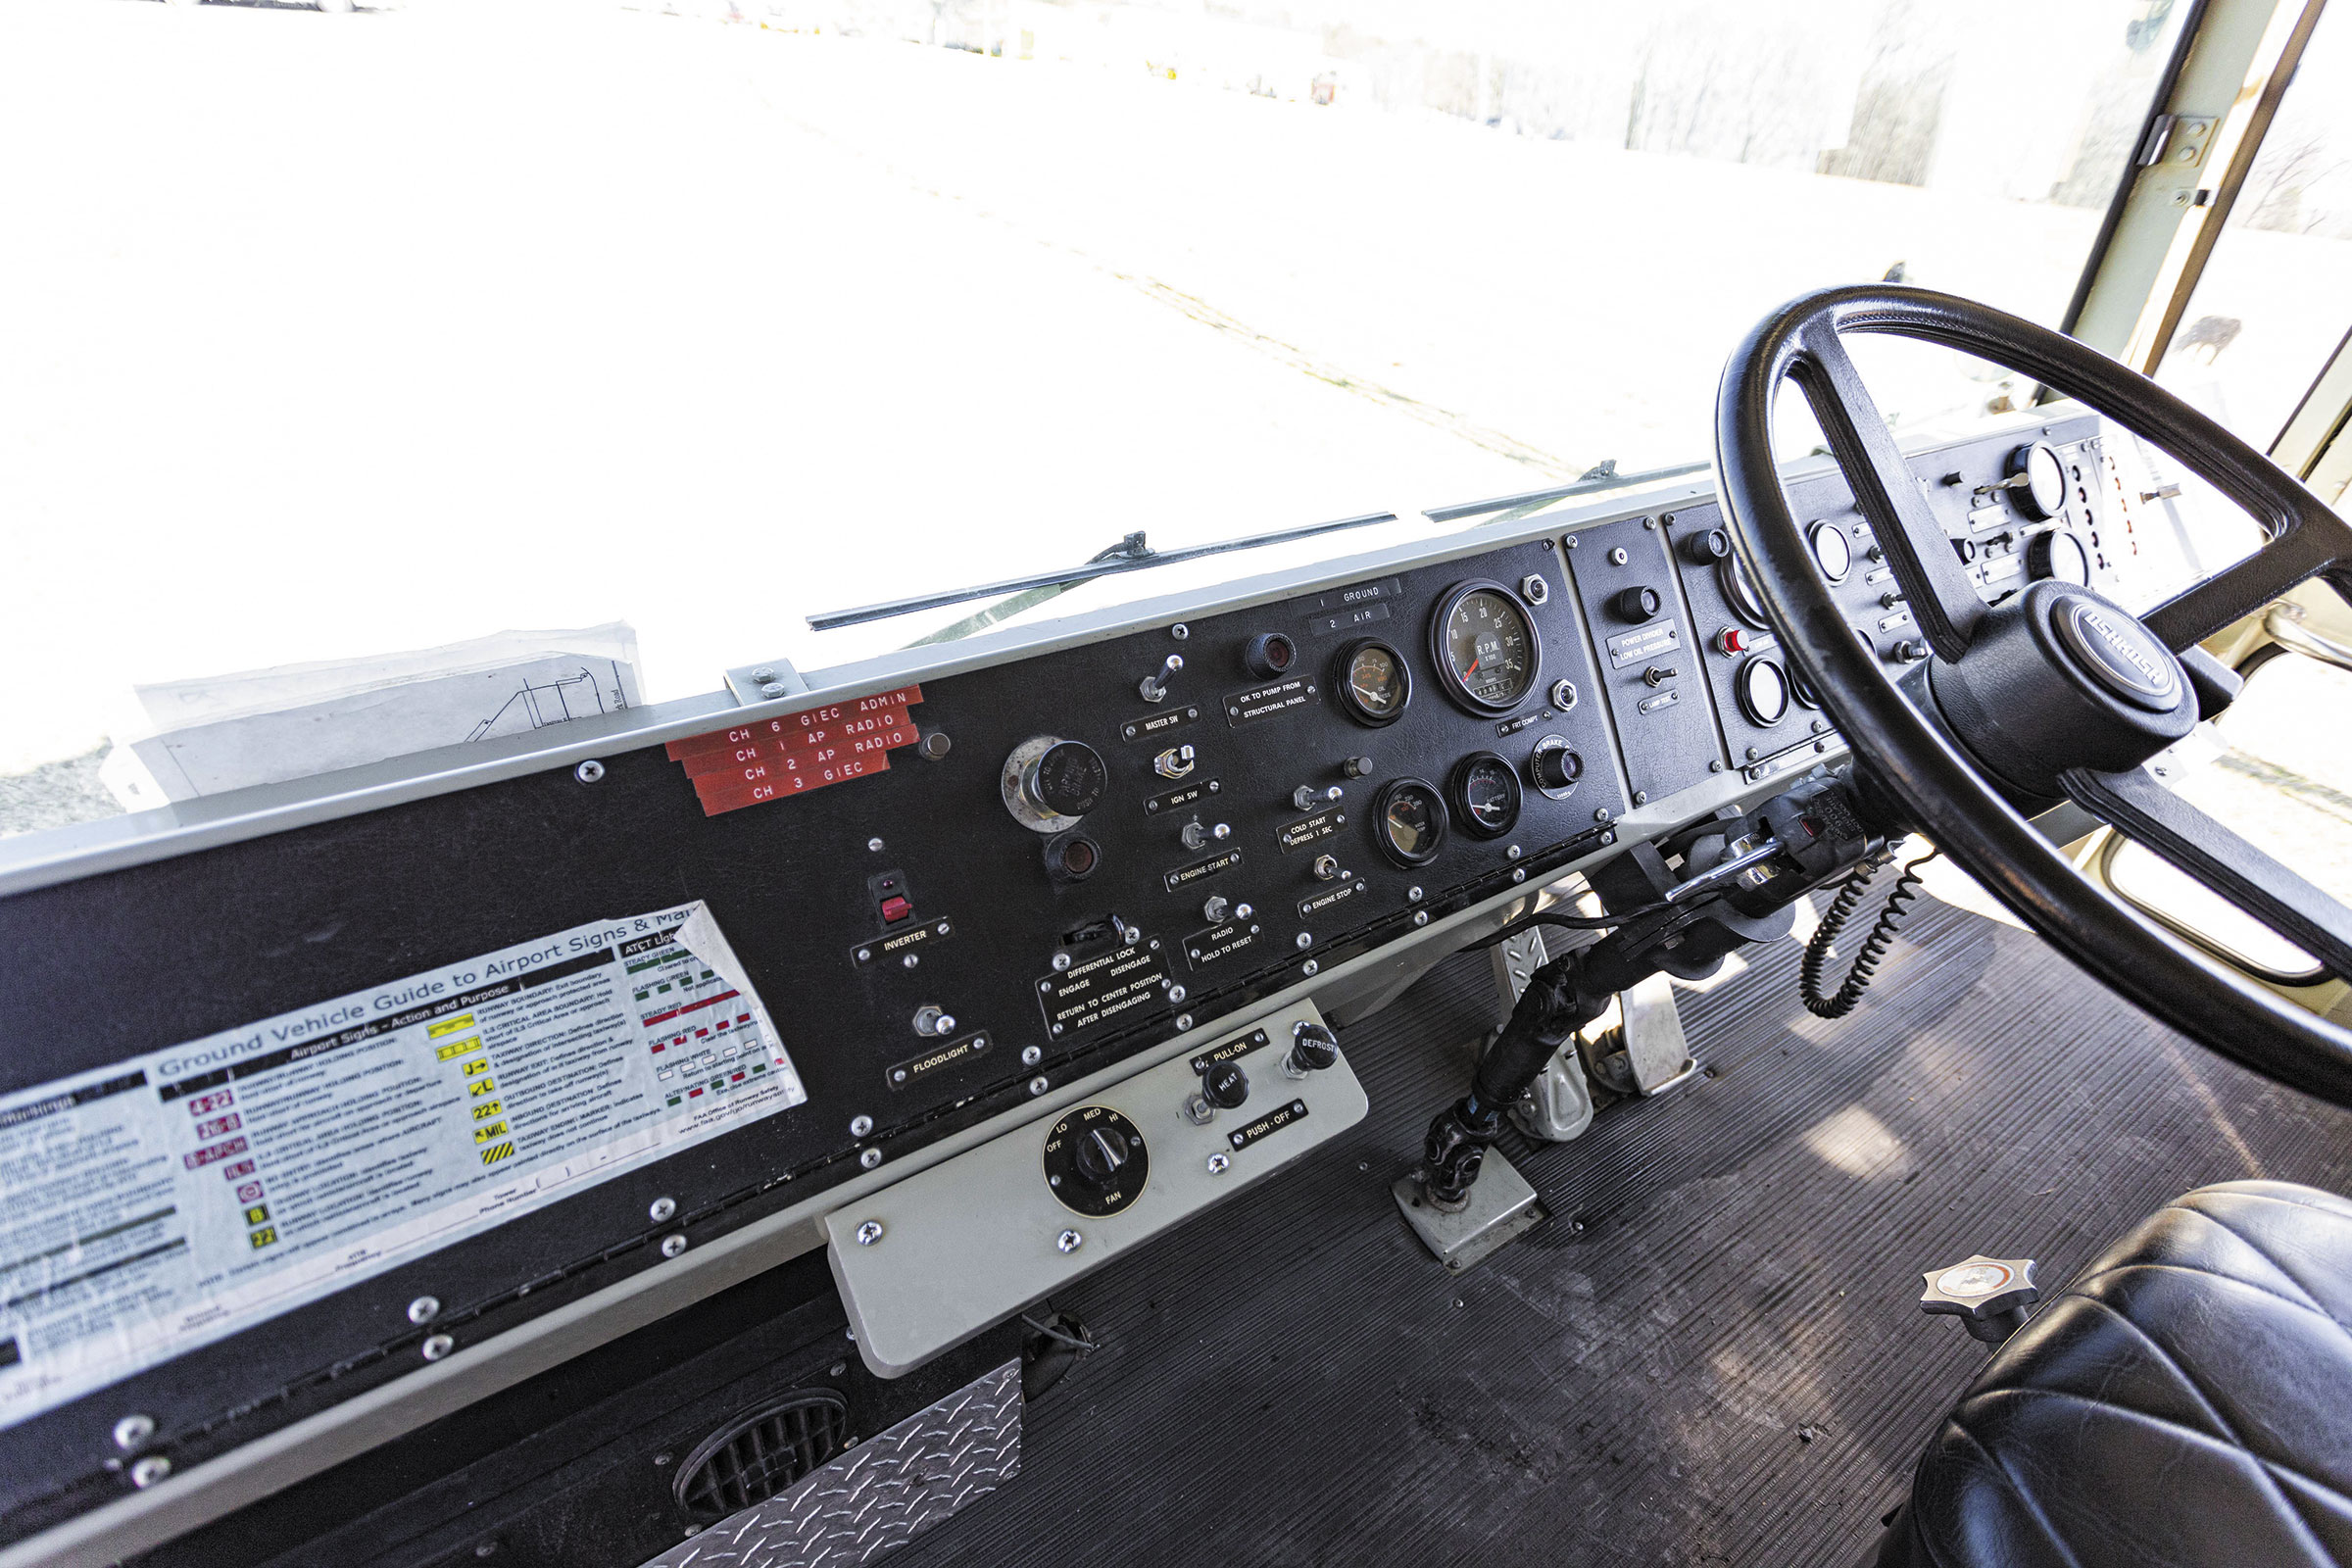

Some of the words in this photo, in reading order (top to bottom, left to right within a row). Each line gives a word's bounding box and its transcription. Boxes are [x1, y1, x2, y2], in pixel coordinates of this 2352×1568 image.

[1344, 587, 1379, 603] GROUND
[1353, 611, 1371, 622] AIR
[1461, 612, 1468, 622] 15
[1479, 608, 1487, 617] 20
[1494, 617, 1502, 628] 25
[1451, 629, 1457, 639] 10
[1505, 636, 1513, 647] 30
[1622, 635, 1642, 647] POWER
[1642, 628, 1663, 639] DIVIDER
[1477, 641, 1499, 655] R.P.M.
[1620, 651, 1633, 660] LOW
[1634, 647, 1643, 656] OIL
[1643, 638, 1671, 652] PRESSURE
[2084, 612, 2162, 686] OSHKOSH
[1451, 652, 1455, 662] 5
[1505, 659, 1513, 669] 35
[1240, 693, 1251, 703] OK
[1252, 690, 1261, 699] TO
[1262, 686, 1282, 697] PUMP
[1283, 681, 1300, 692] FROM
[1244, 703, 1284, 718] STRUCTURAL
[1286, 696, 1305, 708] PANEL
[729, 729, 750, 742] CH
[771, 721, 780, 732] 6
[801, 708, 839, 726] GIEC
[860, 693, 906, 711] ADMIN
[1146, 717, 1167, 731] MASTER
[1168, 715, 1179, 724] SW
[1522, 715, 1538, 725] COMPT
[736, 748, 756, 760] CH
[808, 731, 825, 744] AP
[846, 714, 894, 734] RADIO
[745, 767, 765, 780] CH
[788, 759, 796, 770] 2
[818, 749, 835, 762] AP
[855, 733, 903, 753] RADIO
[1535, 749, 1545, 788] COMPUTER
[1543, 740, 1562, 749] BRAKE
[754, 786, 773, 799] CH
[795, 777, 802, 788] 3
[824, 762, 862, 780] GIEC
[1170, 793, 1184, 804] IGN
[1185, 790, 1198, 801] SW
[1290, 823, 1307, 834] COLD
[1308, 816, 1326, 829] START
[1290, 832, 1314, 846] DEPRESS
[1320, 826, 1333, 836] SEC
[1180, 866, 1207, 881] ENGINE
[1208, 858, 1229, 871] START
[1312, 895, 1334, 909] ENGINE
[1335, 889, 1352, 901] STOP
[884, 931, 926, 951] INVERTER
[1211, 927, 1233, 941] RADIO
[625, 938, 651, 954] ATCT
[1201, 950, 1220, 962] HOLD
[1232, 936, 1252, 949] RESET
[1067, 956, 1114, 979] DIFFERENTIAL
[1115, 948, 1136, 961] LOCK
[1058, 979, 1090, 998] ENGAGE
[1110, 955, 1151, 977] DISENGAGE
[157, 1033, 263, 1076] Ground
[270, 1005, 365, 1041] Vehicle
[372, 981, 444, 1010] Guide
[452, 972, 476, 987] to
[485, 944, 563, 978] Airport
[567, 926, 627, 952] Signs
[633, 918, 650, 932] &
[1057, 1004, 1085, 1020] RETURN
[1088, 998, 1099, 1007] TO
[1101, 987, 1128, 1004] CENTER
[1129, 973, 1162, 995] POSITION
[477, 1001, 508, 1013] RUNWAY
[1077, 1013, 1100, 1028] AFTER
[1102, 992, 1151, 1018] DISENGAGING
[291, 1038, 337, 1059] Airport
[340, 1025, 377, 1043] Signs
[391, 1008, 430, 1028] Action
[434, 999, 457, 1013] and
[460, 985, 509, 1005] Purpose
[648, 1030, 681, 1045] FLASHING
[1302, 1038, 1336, 1052] DEFROST
[913, 1046, 968, 1073] FLOODLIGHT
[1214, 1042, 1247, 1061] PULL-ON
[466, 1063, 473, 1075] J
[656, 1056, 689, 1072] FLASHING
[690, 1049, 710, 1059] WHITE
[481, 1080, 492, 1092] L
[1219, 1072, 1238, 1092] HEAT
[473, 1104, 491, 1119] 22
[1084, 1107, 1102, 1121] MED
[1108, 1112, 1119, 1123] HI
[484, 1123, 506, 1138] MIL
[1056, 1123, 1068, 1133] LO
[1247, 1121, 1269, 1139] PUSH
[1274, 1110, 1291, 1124] OFF
[1047, 1140, 1062, 1152] OFF
[1105, 1192, 1121, 1205] FAN
